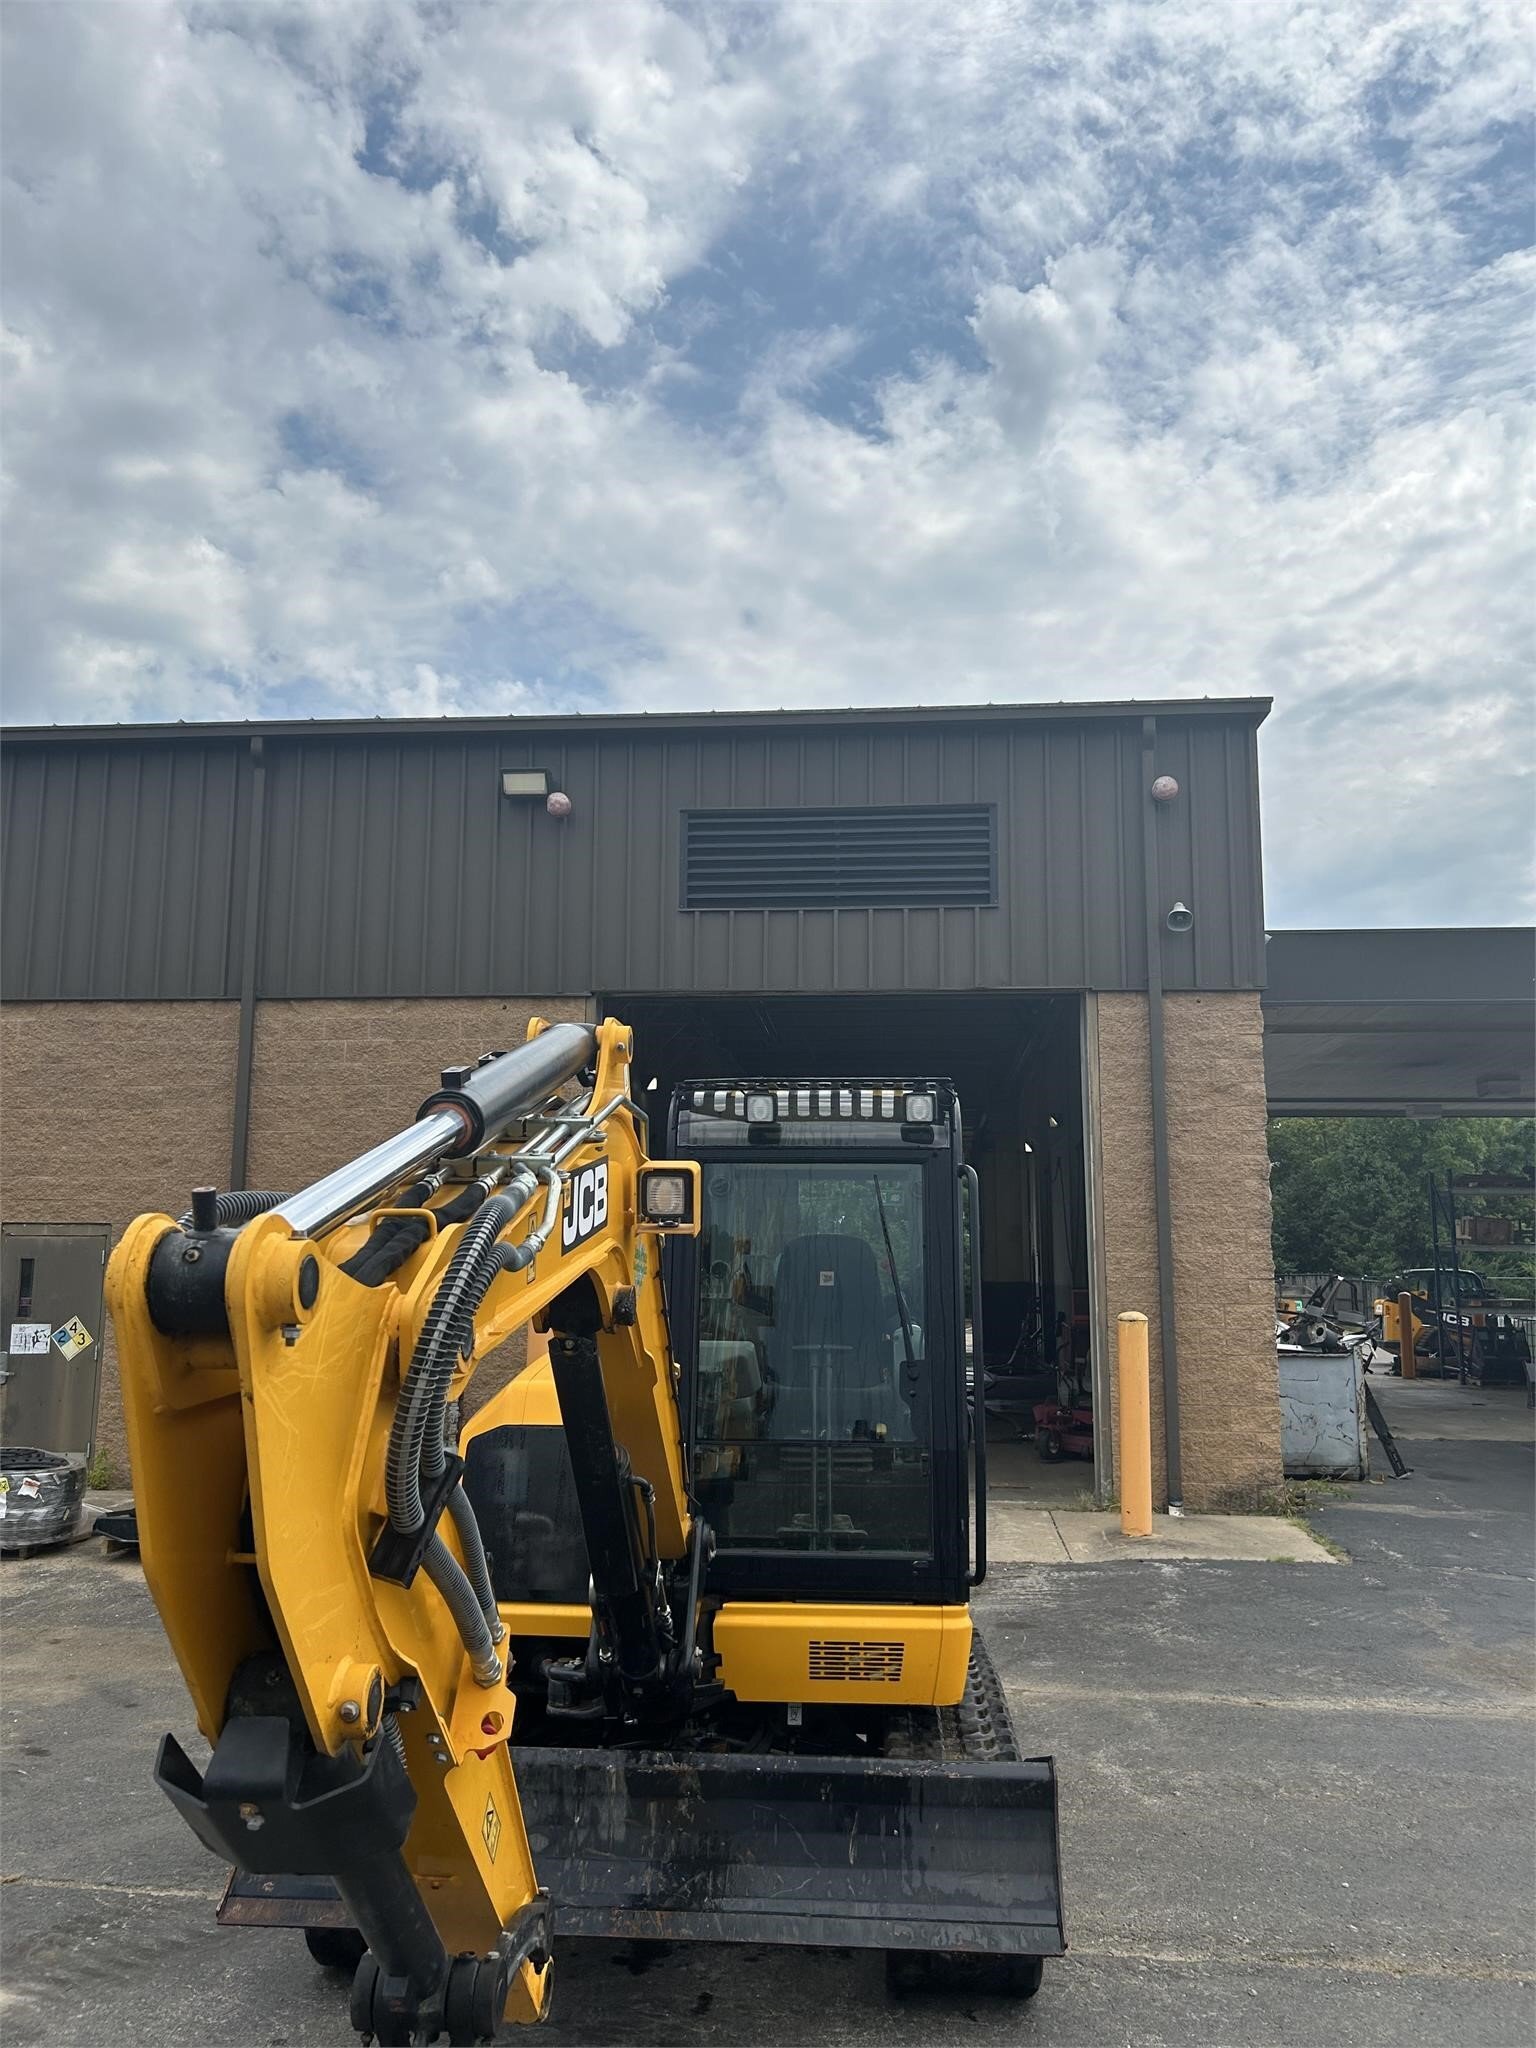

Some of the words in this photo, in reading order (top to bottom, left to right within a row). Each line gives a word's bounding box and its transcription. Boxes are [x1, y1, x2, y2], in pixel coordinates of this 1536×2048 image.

[563, 1163, 608, 1246] JCB
[69, 1321, 78, 1334] 4
[58, 1329, 67, 1343] 2
[77, 1332, 86, 1346] 3
